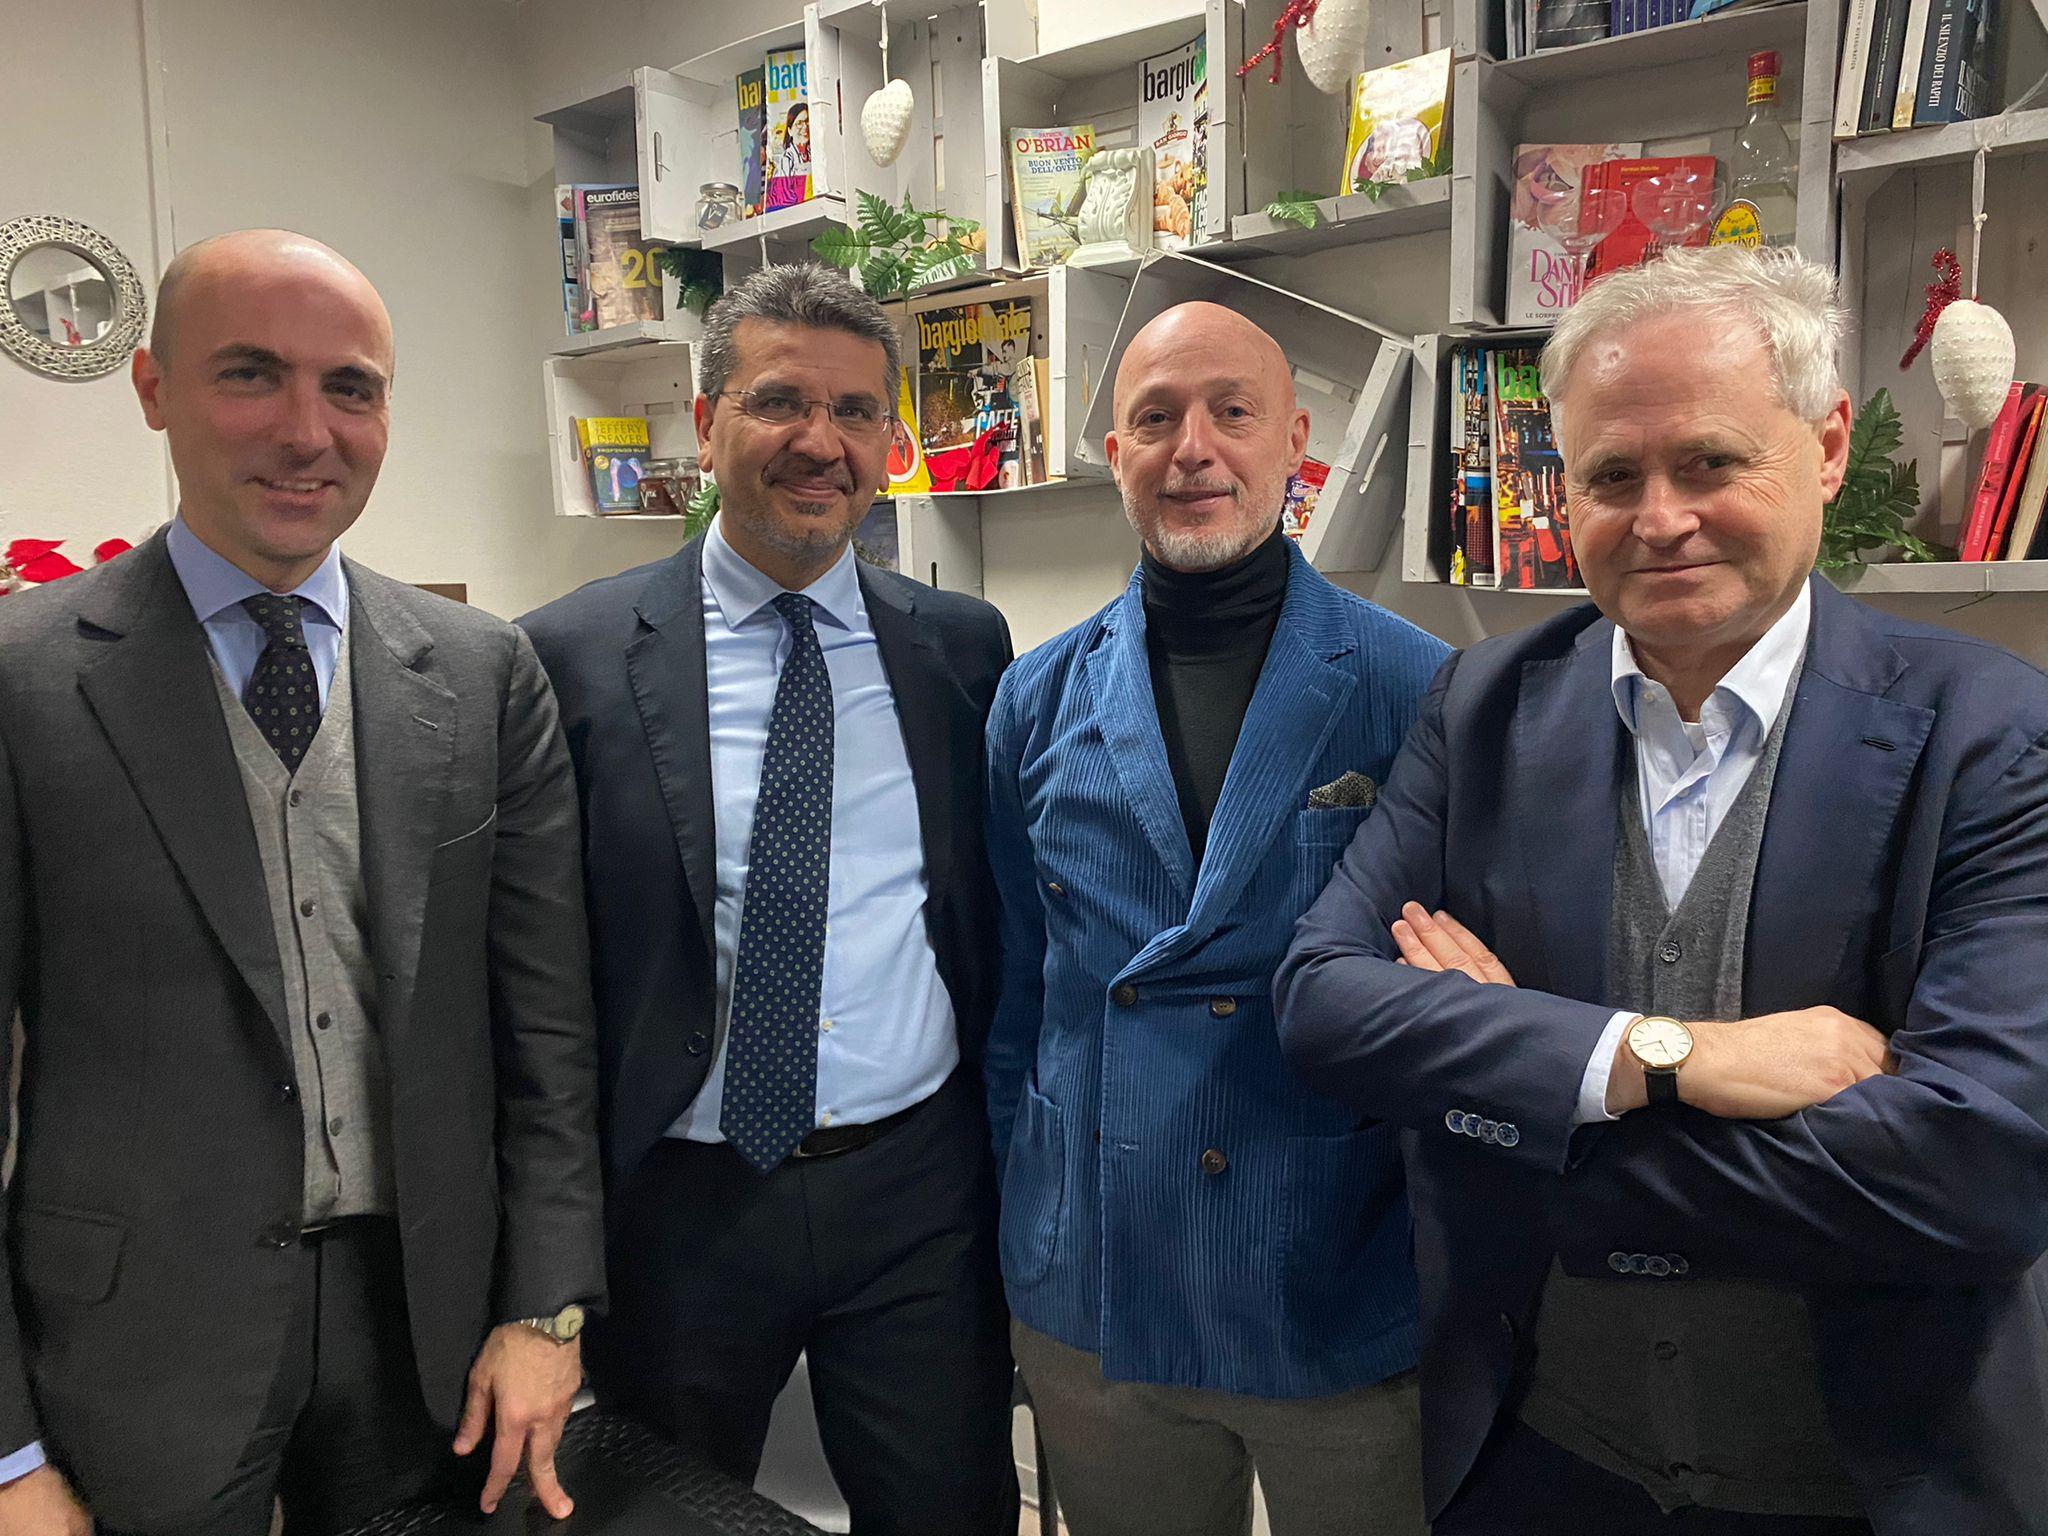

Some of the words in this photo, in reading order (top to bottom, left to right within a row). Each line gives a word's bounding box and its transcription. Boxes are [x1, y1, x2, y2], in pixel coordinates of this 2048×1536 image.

[1936, 23, 1951, 62] SILENZIO
[1932, 63, 1946, 78] DEI
[1928, 80, 1942, 107] RAPITI
[1016, 135, 1091, 153] O'BRIAN
[1028, 159, 1051, 168] BUON
[1053, 157, 1083, 167] VENTO
[1498, 354, 1546, 400] ba
[597, 434, 644, 445] DEAVER
